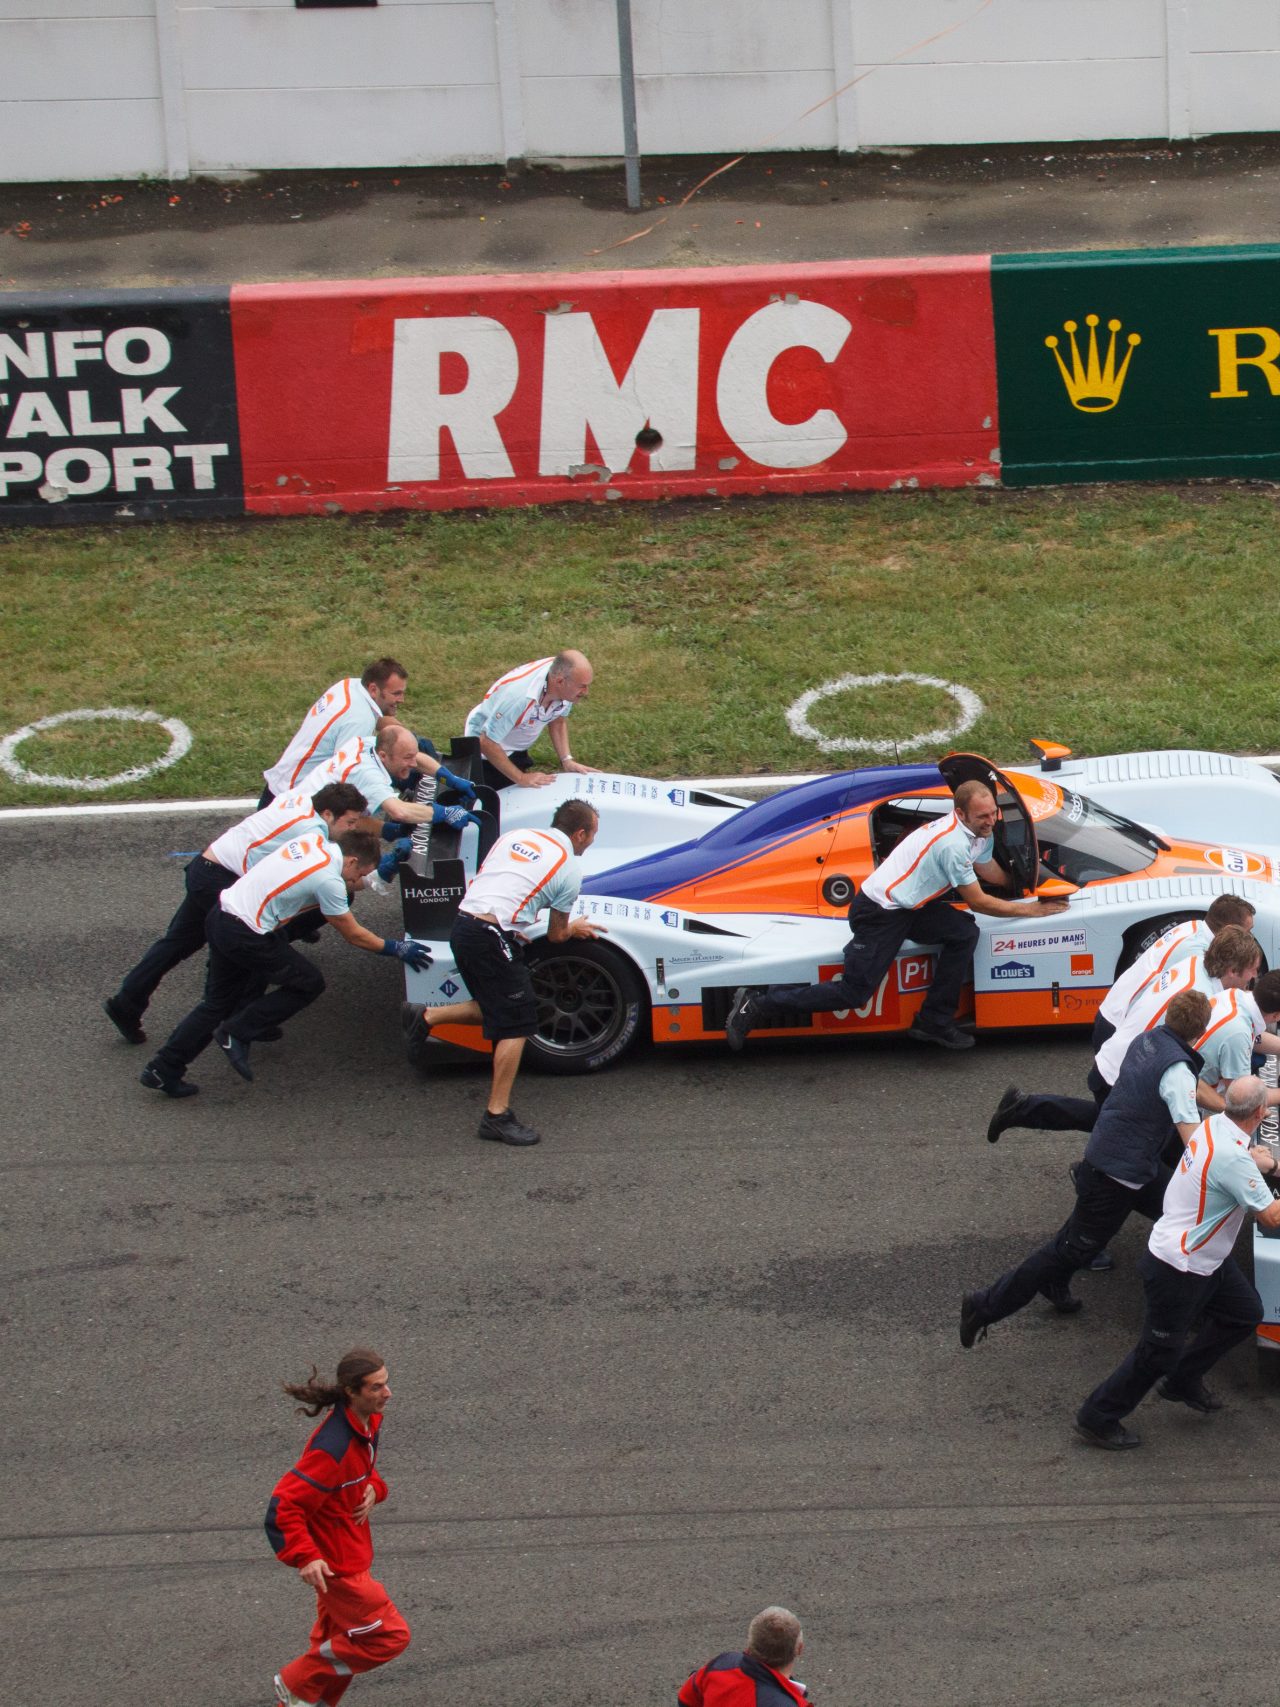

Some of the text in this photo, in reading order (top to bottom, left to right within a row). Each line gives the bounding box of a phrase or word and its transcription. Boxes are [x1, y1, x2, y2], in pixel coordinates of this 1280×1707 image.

[387, 299, 853, 484] RMC
[0, 386, 188, 438] ALK
[289, 841, 303, 860] Gulf
[511, 843, 541, 862] Gulf
[1227, 849, 1244, 873] Gulf
[404, 886, 464, 899] HACKETT
[993, 933, 1085, 952] 24 HEURES DU MANS
[904, 960, 928, 984] P1
[994, 967, 1031, 978] LOWE'S
